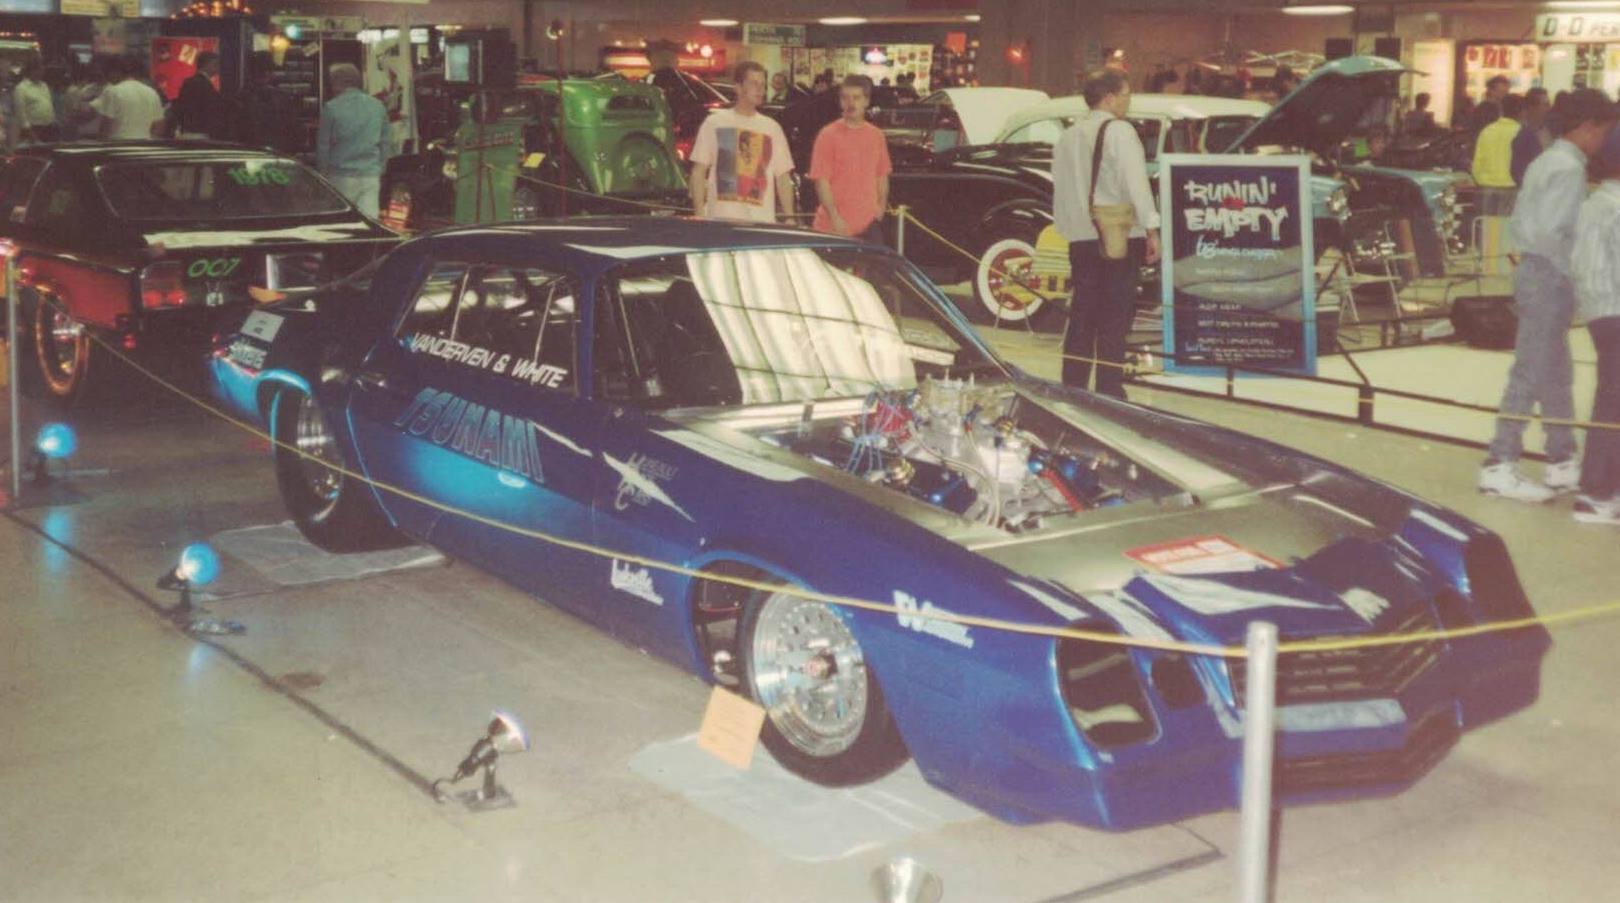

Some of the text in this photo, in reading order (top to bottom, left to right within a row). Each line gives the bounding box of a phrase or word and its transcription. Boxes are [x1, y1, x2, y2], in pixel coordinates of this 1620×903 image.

[1184, 205, 1288, 241] EMPTY
[411, 332, 569, 389] VANDERVEN & WHITE
[392, 386, 545, 484] TSUNAMI
